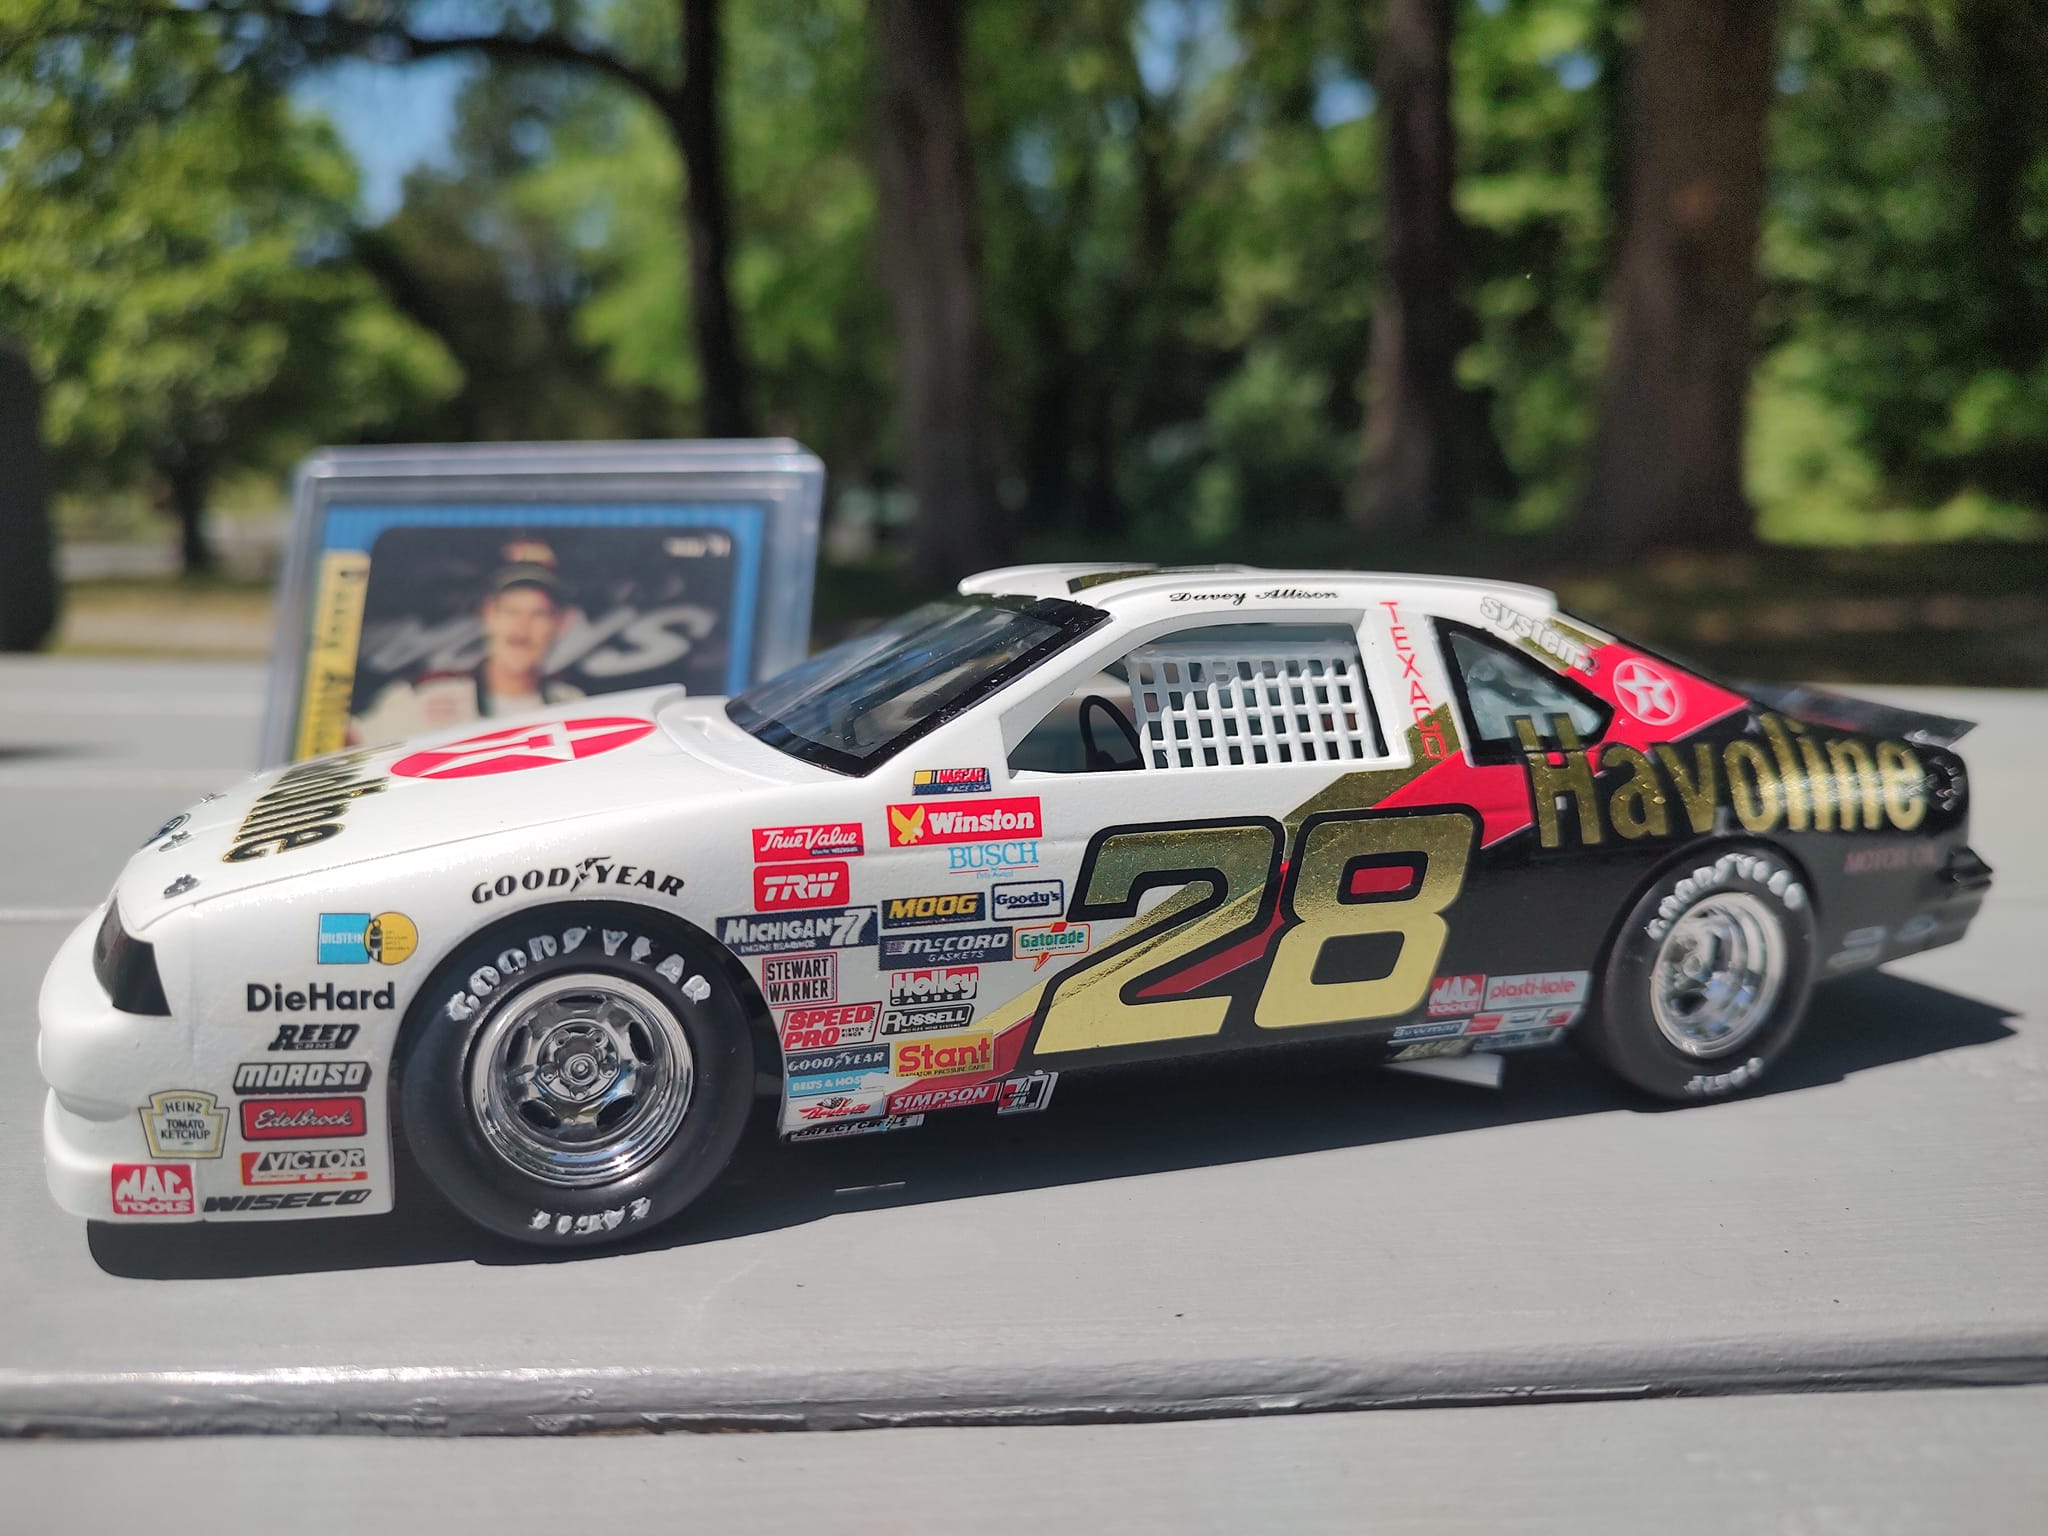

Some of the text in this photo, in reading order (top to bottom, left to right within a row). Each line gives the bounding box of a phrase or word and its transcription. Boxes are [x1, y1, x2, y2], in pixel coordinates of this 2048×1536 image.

[1169, 589, 1339, 606] Davey Allison
[1380, 601, 1447, 760] TEXACO
[938, 768, 985, 783] NASCAR
[1507, 712, 1928, 848] Havoline
[928, 809, 1035, 835] Winston
[760, 826, 857, 852] True Value
[948, 841, 1039, 869] BUSCH
[471, 856, 685, 904] GOODYEAR
[763, 871, 840, 902] TRW
[889, 894, 979, 919] MOOG
[995, 890, 1060, 909] Goody's
[829, 907, 876, 946] 77
[1028, 803, 1484, 1058] 28
[1021, 930, 1084, 948] Gatorade
[928, 950, 985, 962] GASKETS
[767, 959, 829, 981] STEWART
[769, 980, 829, 1003] WARNER
[891, 969, 978, 999] Holley
[1429, 976, 1480, 1002] MAC
[247, 982, 396, 1012] DieHard
[787, 1005, 875, 1031] SPEED
[267, 1024, 360, 1051] REED
[784, 1027, 840, 1048] PRO
[788, 1052, 884, 1071] GOODYEAR
[899, 1037, 991, 1073] Stant
[234, 1062, 371, 1094] MOROSO
[824, 1079, 833, 1088] &
[165, 1101, 202, 1114] HEINZ
[891, 1086, 990, 1110] SIMPSON
[166, 1119, 205, 1129] TOMATO
[254, 1108, 354, 1130] Edelbrock
[161, 1129, 211, 1140] KETCHUP
[267, 1150, 366, 1171] VICTOR
[116, 1166, 193, 1200] MAC
[118, 1200, 191, 1213] TOOLS
[203, 1189, 373, 1213] WISECO
